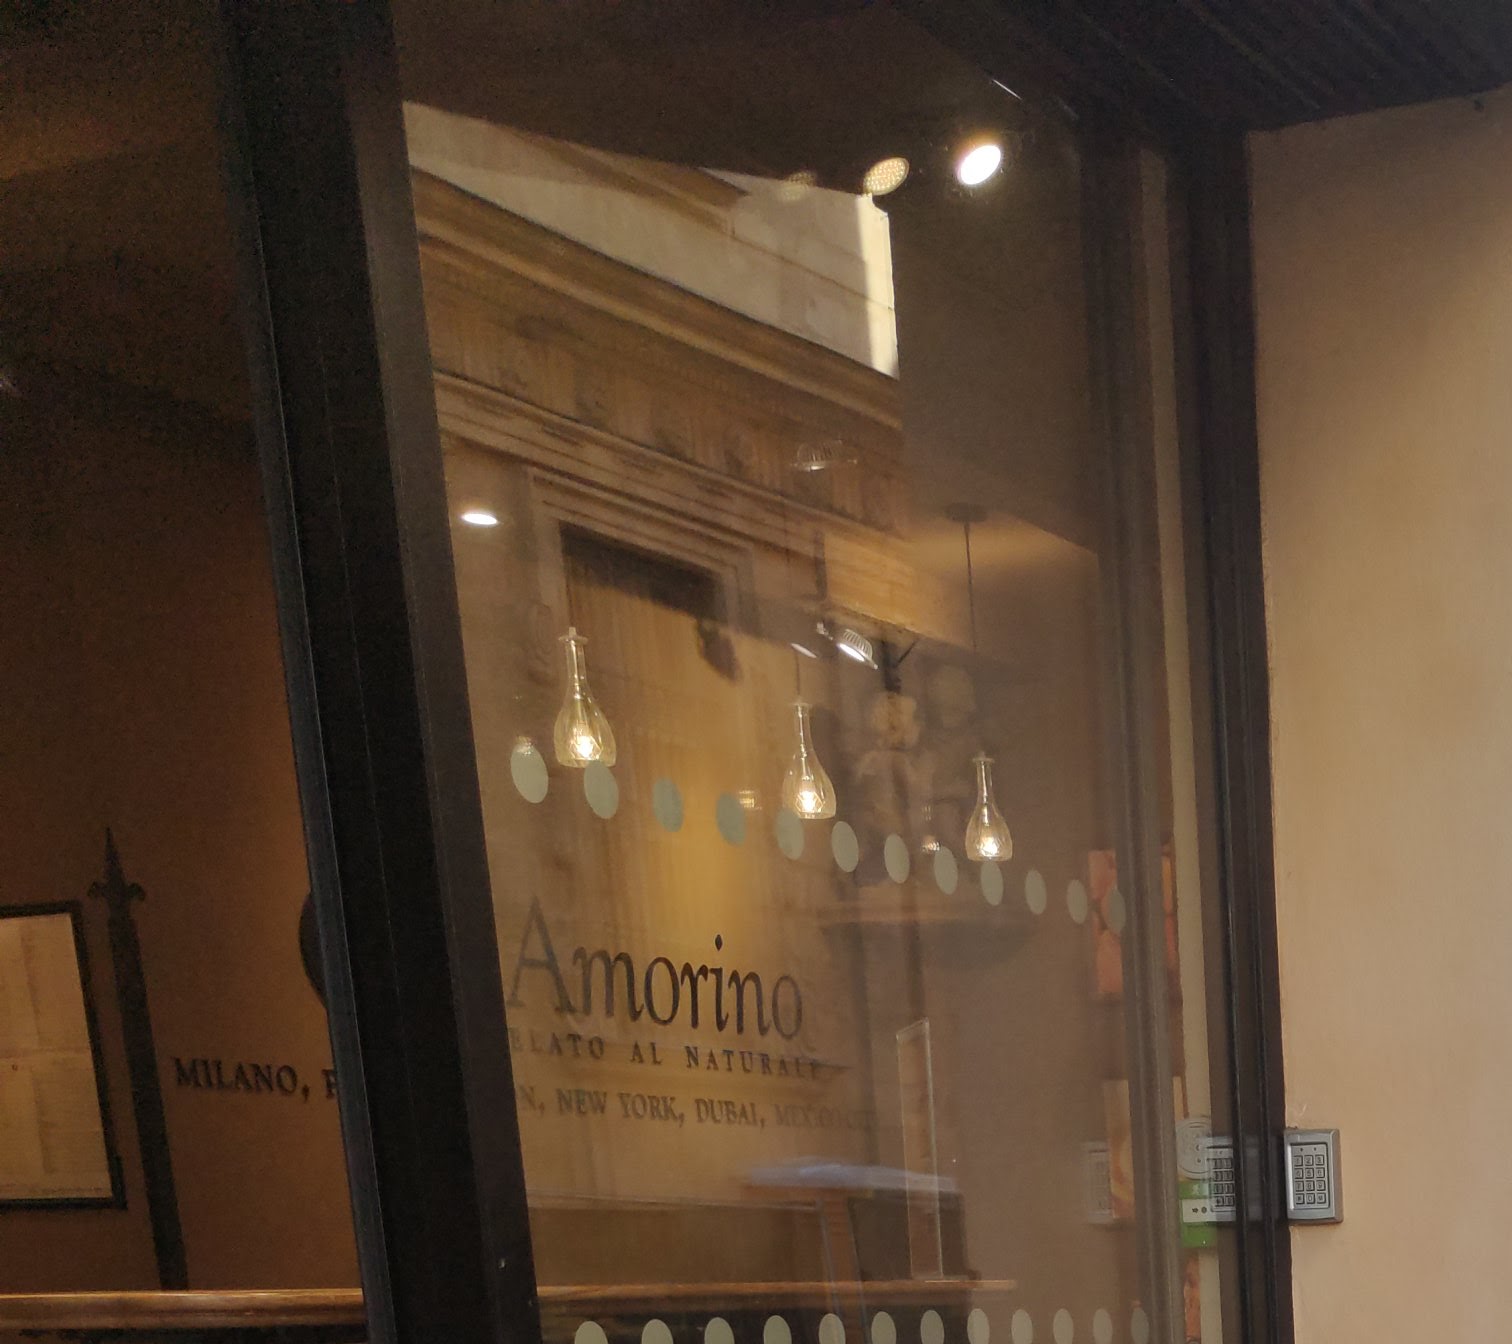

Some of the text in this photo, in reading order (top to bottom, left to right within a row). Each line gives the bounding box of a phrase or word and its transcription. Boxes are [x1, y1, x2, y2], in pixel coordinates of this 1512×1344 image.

[506, 895, 803, 1040] Amorino
[508, 1026, 605, 1061] ELATO
[629, 1040, 664, 1066] AL
[172, 1057, 310, 1100] MILANO,
[555, 1088, 608, 1117] NEW
[617, 1092, 685, 1129] YORK,
[694, 1098, 765, 1129] DUBAI,
